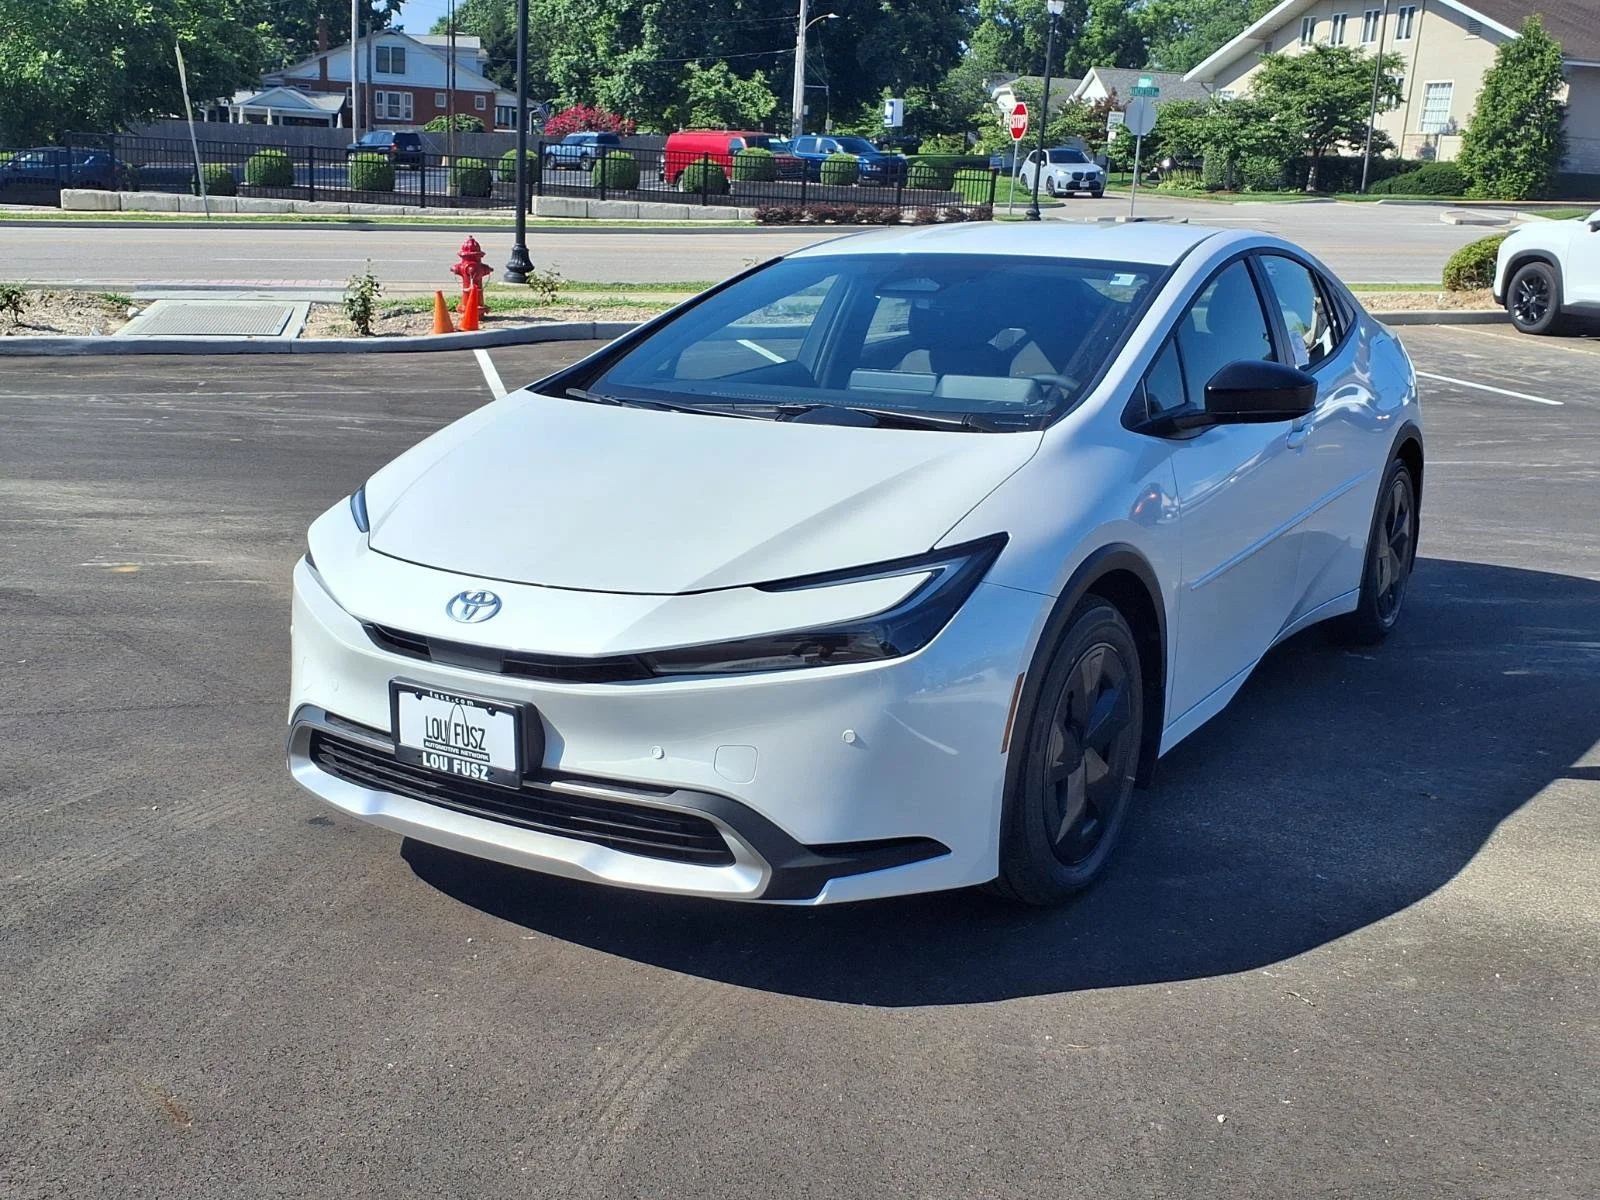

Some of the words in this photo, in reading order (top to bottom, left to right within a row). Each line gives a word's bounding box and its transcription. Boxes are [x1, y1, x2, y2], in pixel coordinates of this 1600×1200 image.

[1010, 115, 1026, 129] STOP
[429, 690, 474, 706] fusz.com
[425, 715, 448, 742] LOU
[454, 722, 486, 751] FUSZ
[425, 740, 460, 754] AUTOMOTIVE
[460, 748, 489, 761] NETWORK
[422, 751, 448, 771] LOU
[453, 758, 489, 781] FUSZ
